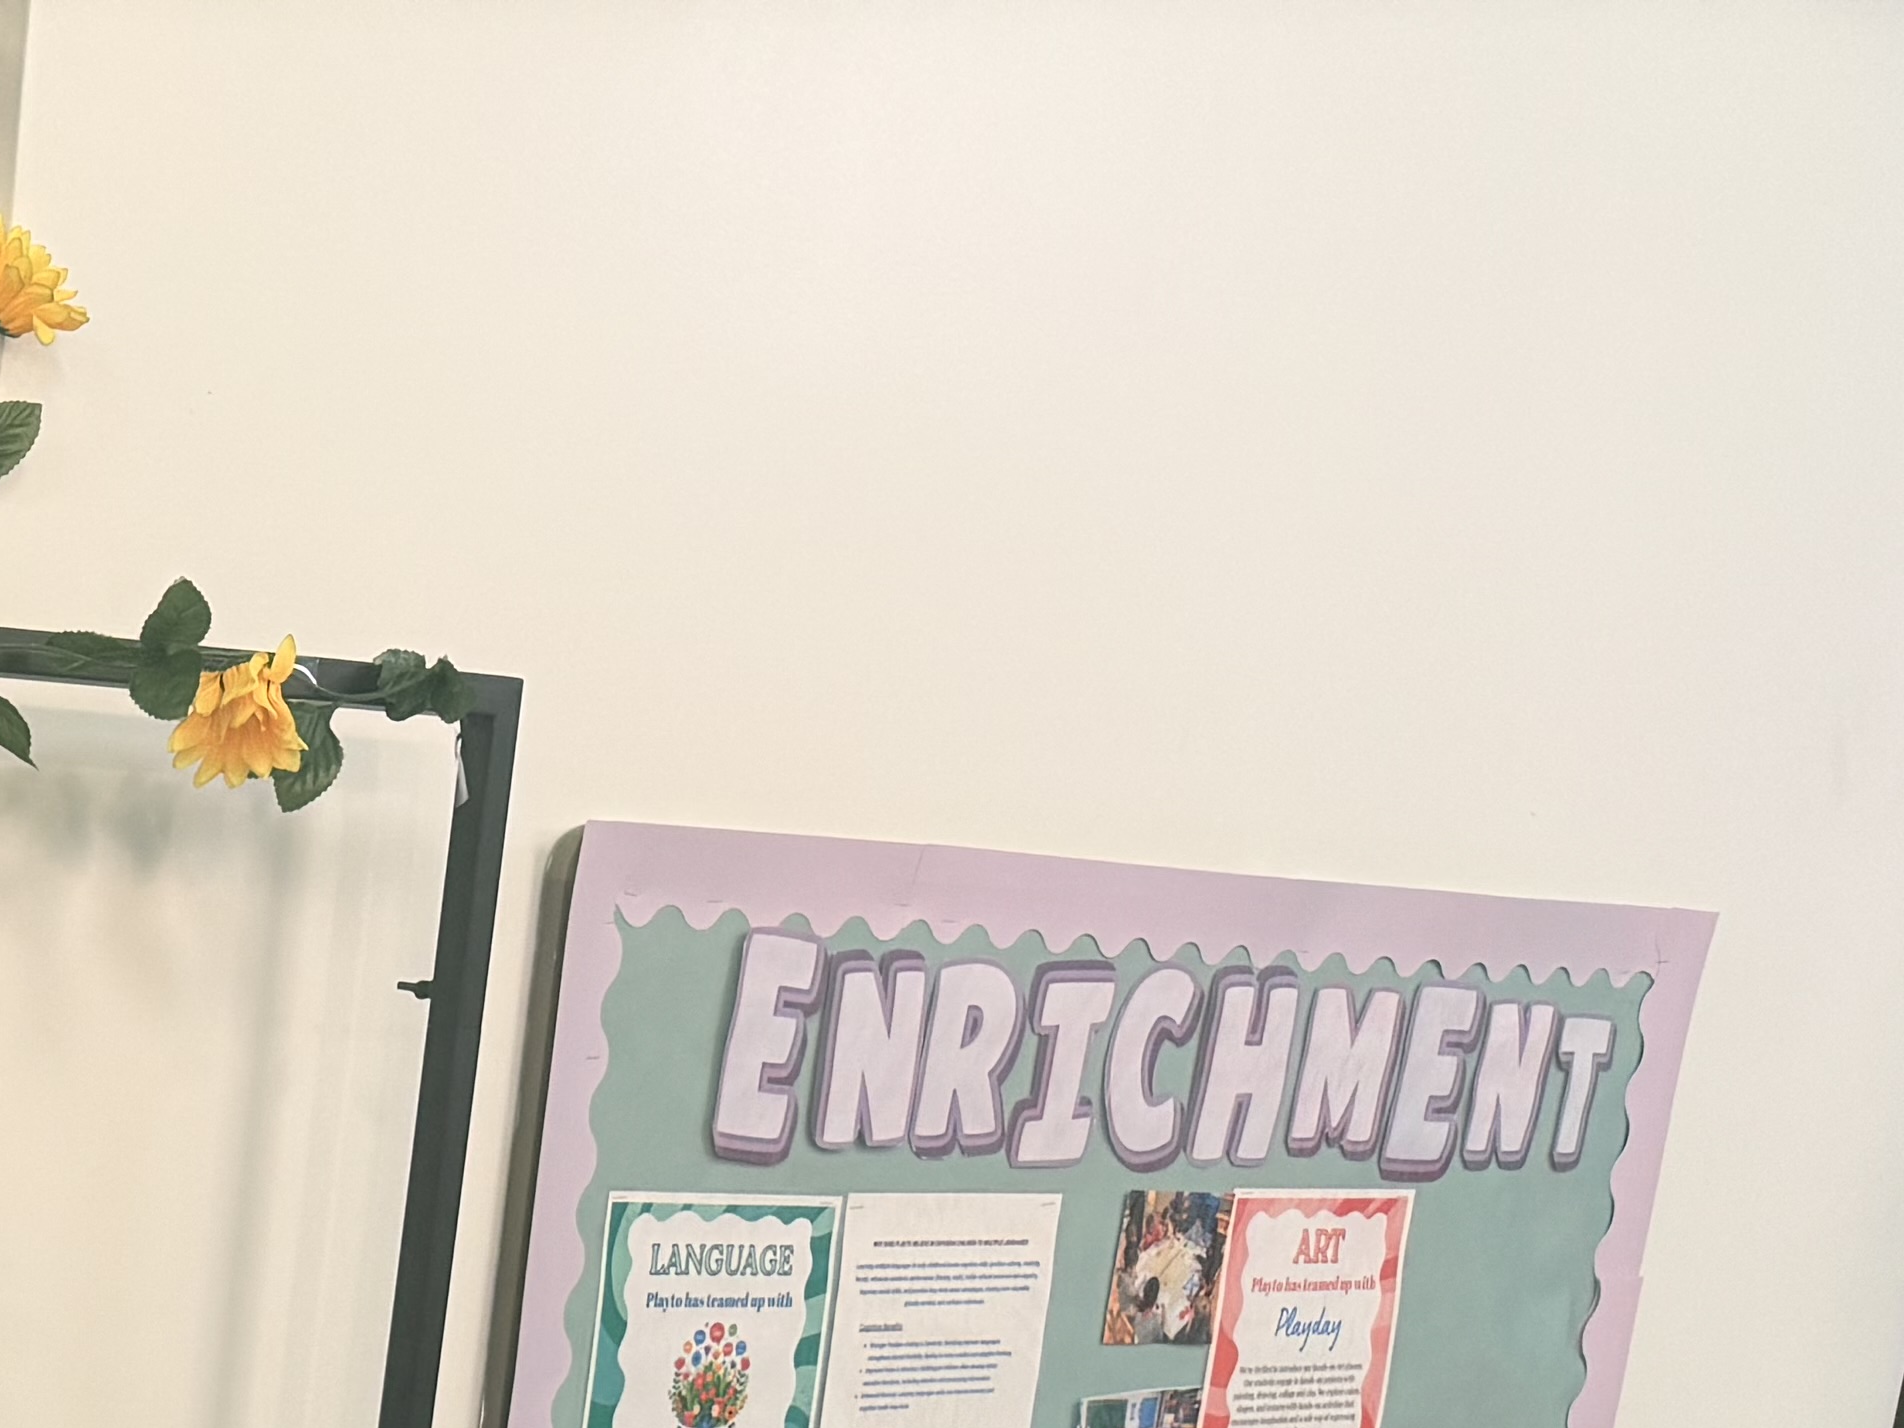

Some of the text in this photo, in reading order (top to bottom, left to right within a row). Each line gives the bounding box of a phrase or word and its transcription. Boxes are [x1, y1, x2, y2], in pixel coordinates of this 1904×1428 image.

[711, 925, 1616, 1176] ENRICHMENT
[649, 1243, 794, 1276] LANGUAGE
[1293, 1228, 1346, 1264] ART
[646, 1292, 793, 1312] Playto has teamed up with
[1252, 1275, 1376, 1297] Playto has teamed up with
[1274, 1306, 1342, 1352] Playday
